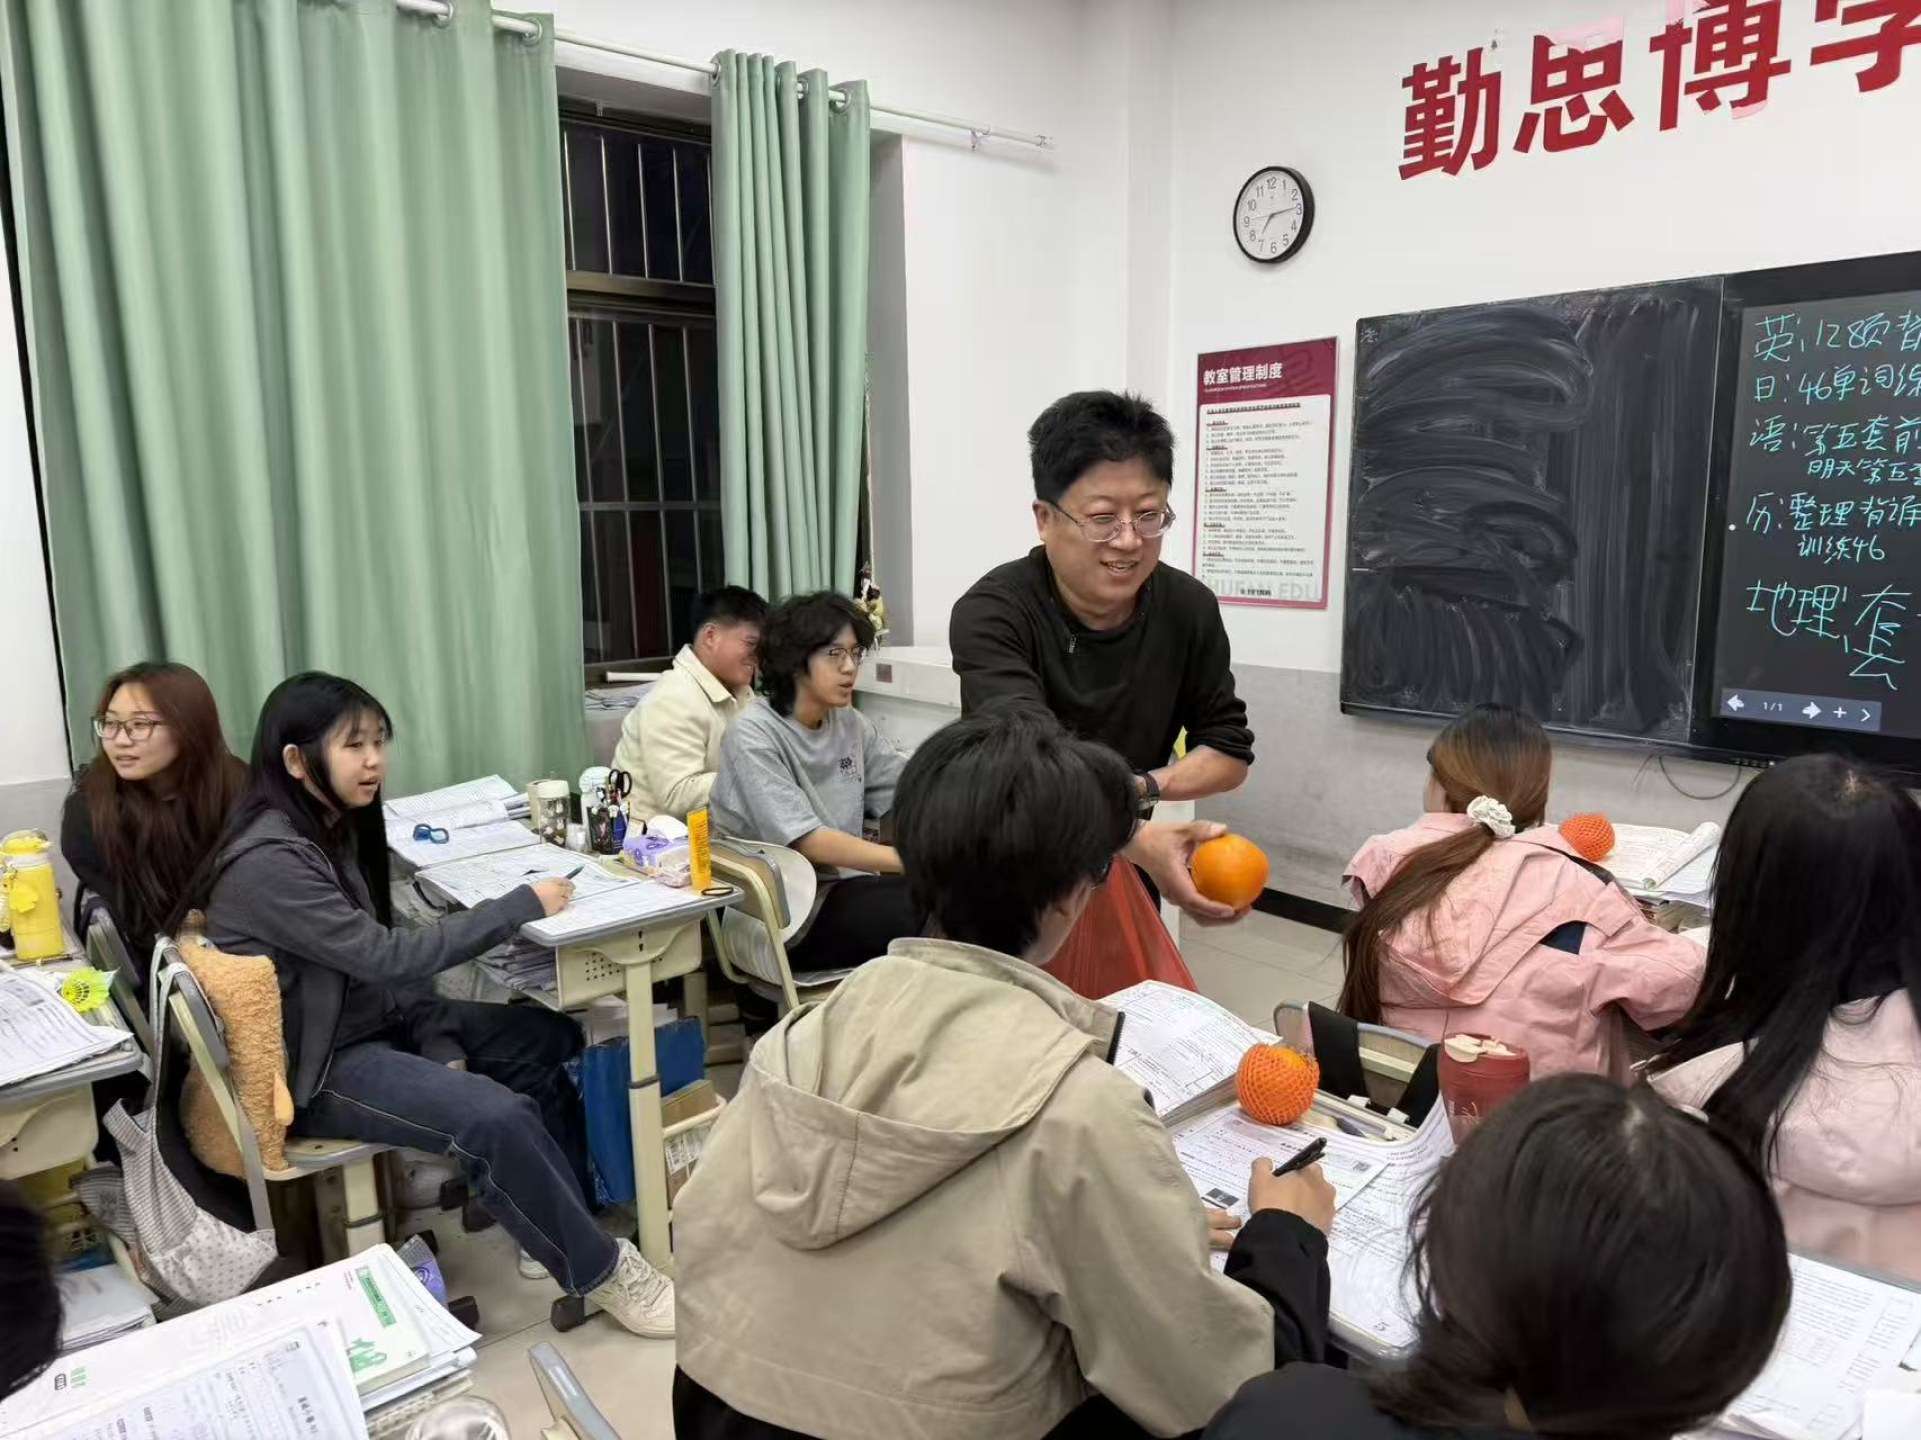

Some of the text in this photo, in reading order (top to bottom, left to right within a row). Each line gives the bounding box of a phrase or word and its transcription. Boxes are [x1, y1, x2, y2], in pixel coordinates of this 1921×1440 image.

[1399, 0, 1921, 180] 勤思博学
[1203, 362, 1283, 386] 教室管理制度
[1797, 533, 1886, 564] 训练46
[1763, 701, 1784, 713] 1/1
